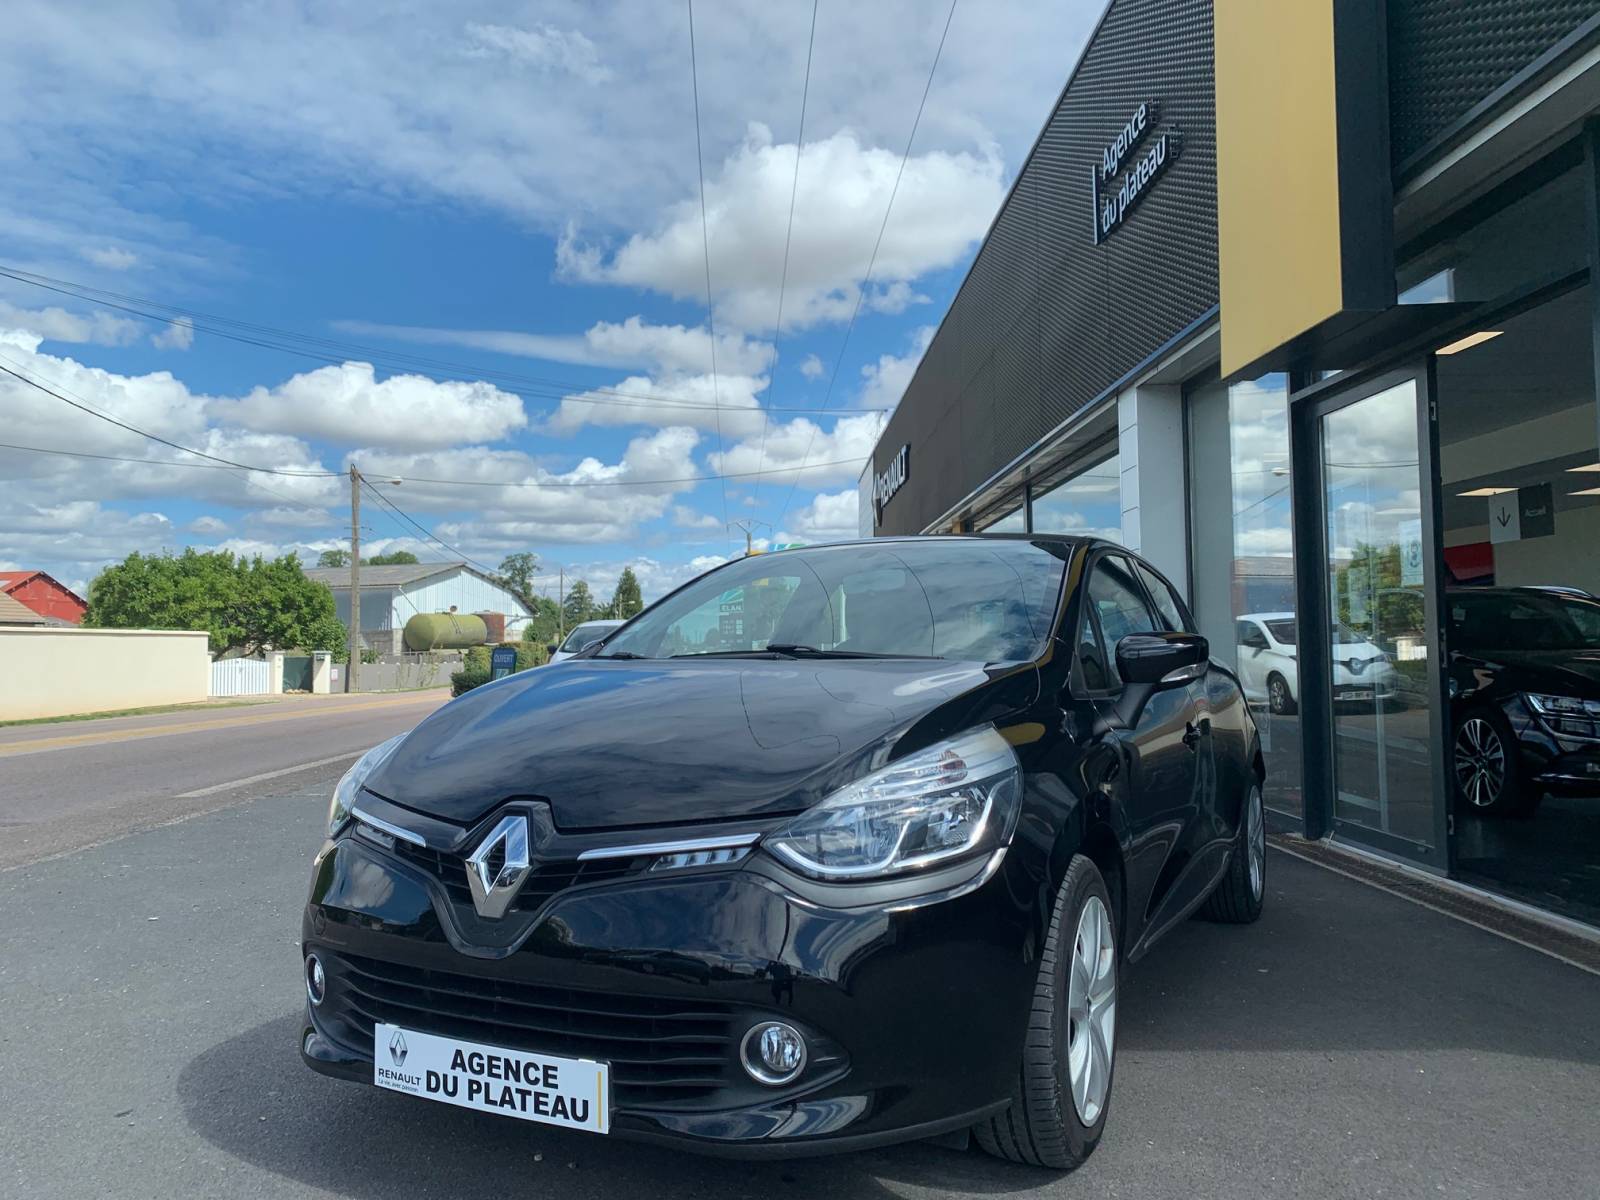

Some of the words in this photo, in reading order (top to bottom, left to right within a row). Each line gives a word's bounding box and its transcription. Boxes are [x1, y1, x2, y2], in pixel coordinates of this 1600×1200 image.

[1103, 104, 1146, 181] Agence
[1102, 198, 1117, 233] du
[1119, 135, 1166, 222] plateau
[378, 1068, 422, 1086] RENAULT
[450, 1049, 559, 1089] AGENCE
[426, 1070, 459, 1097] DU
[467, 1078, 589, 1122] PLATEAU
